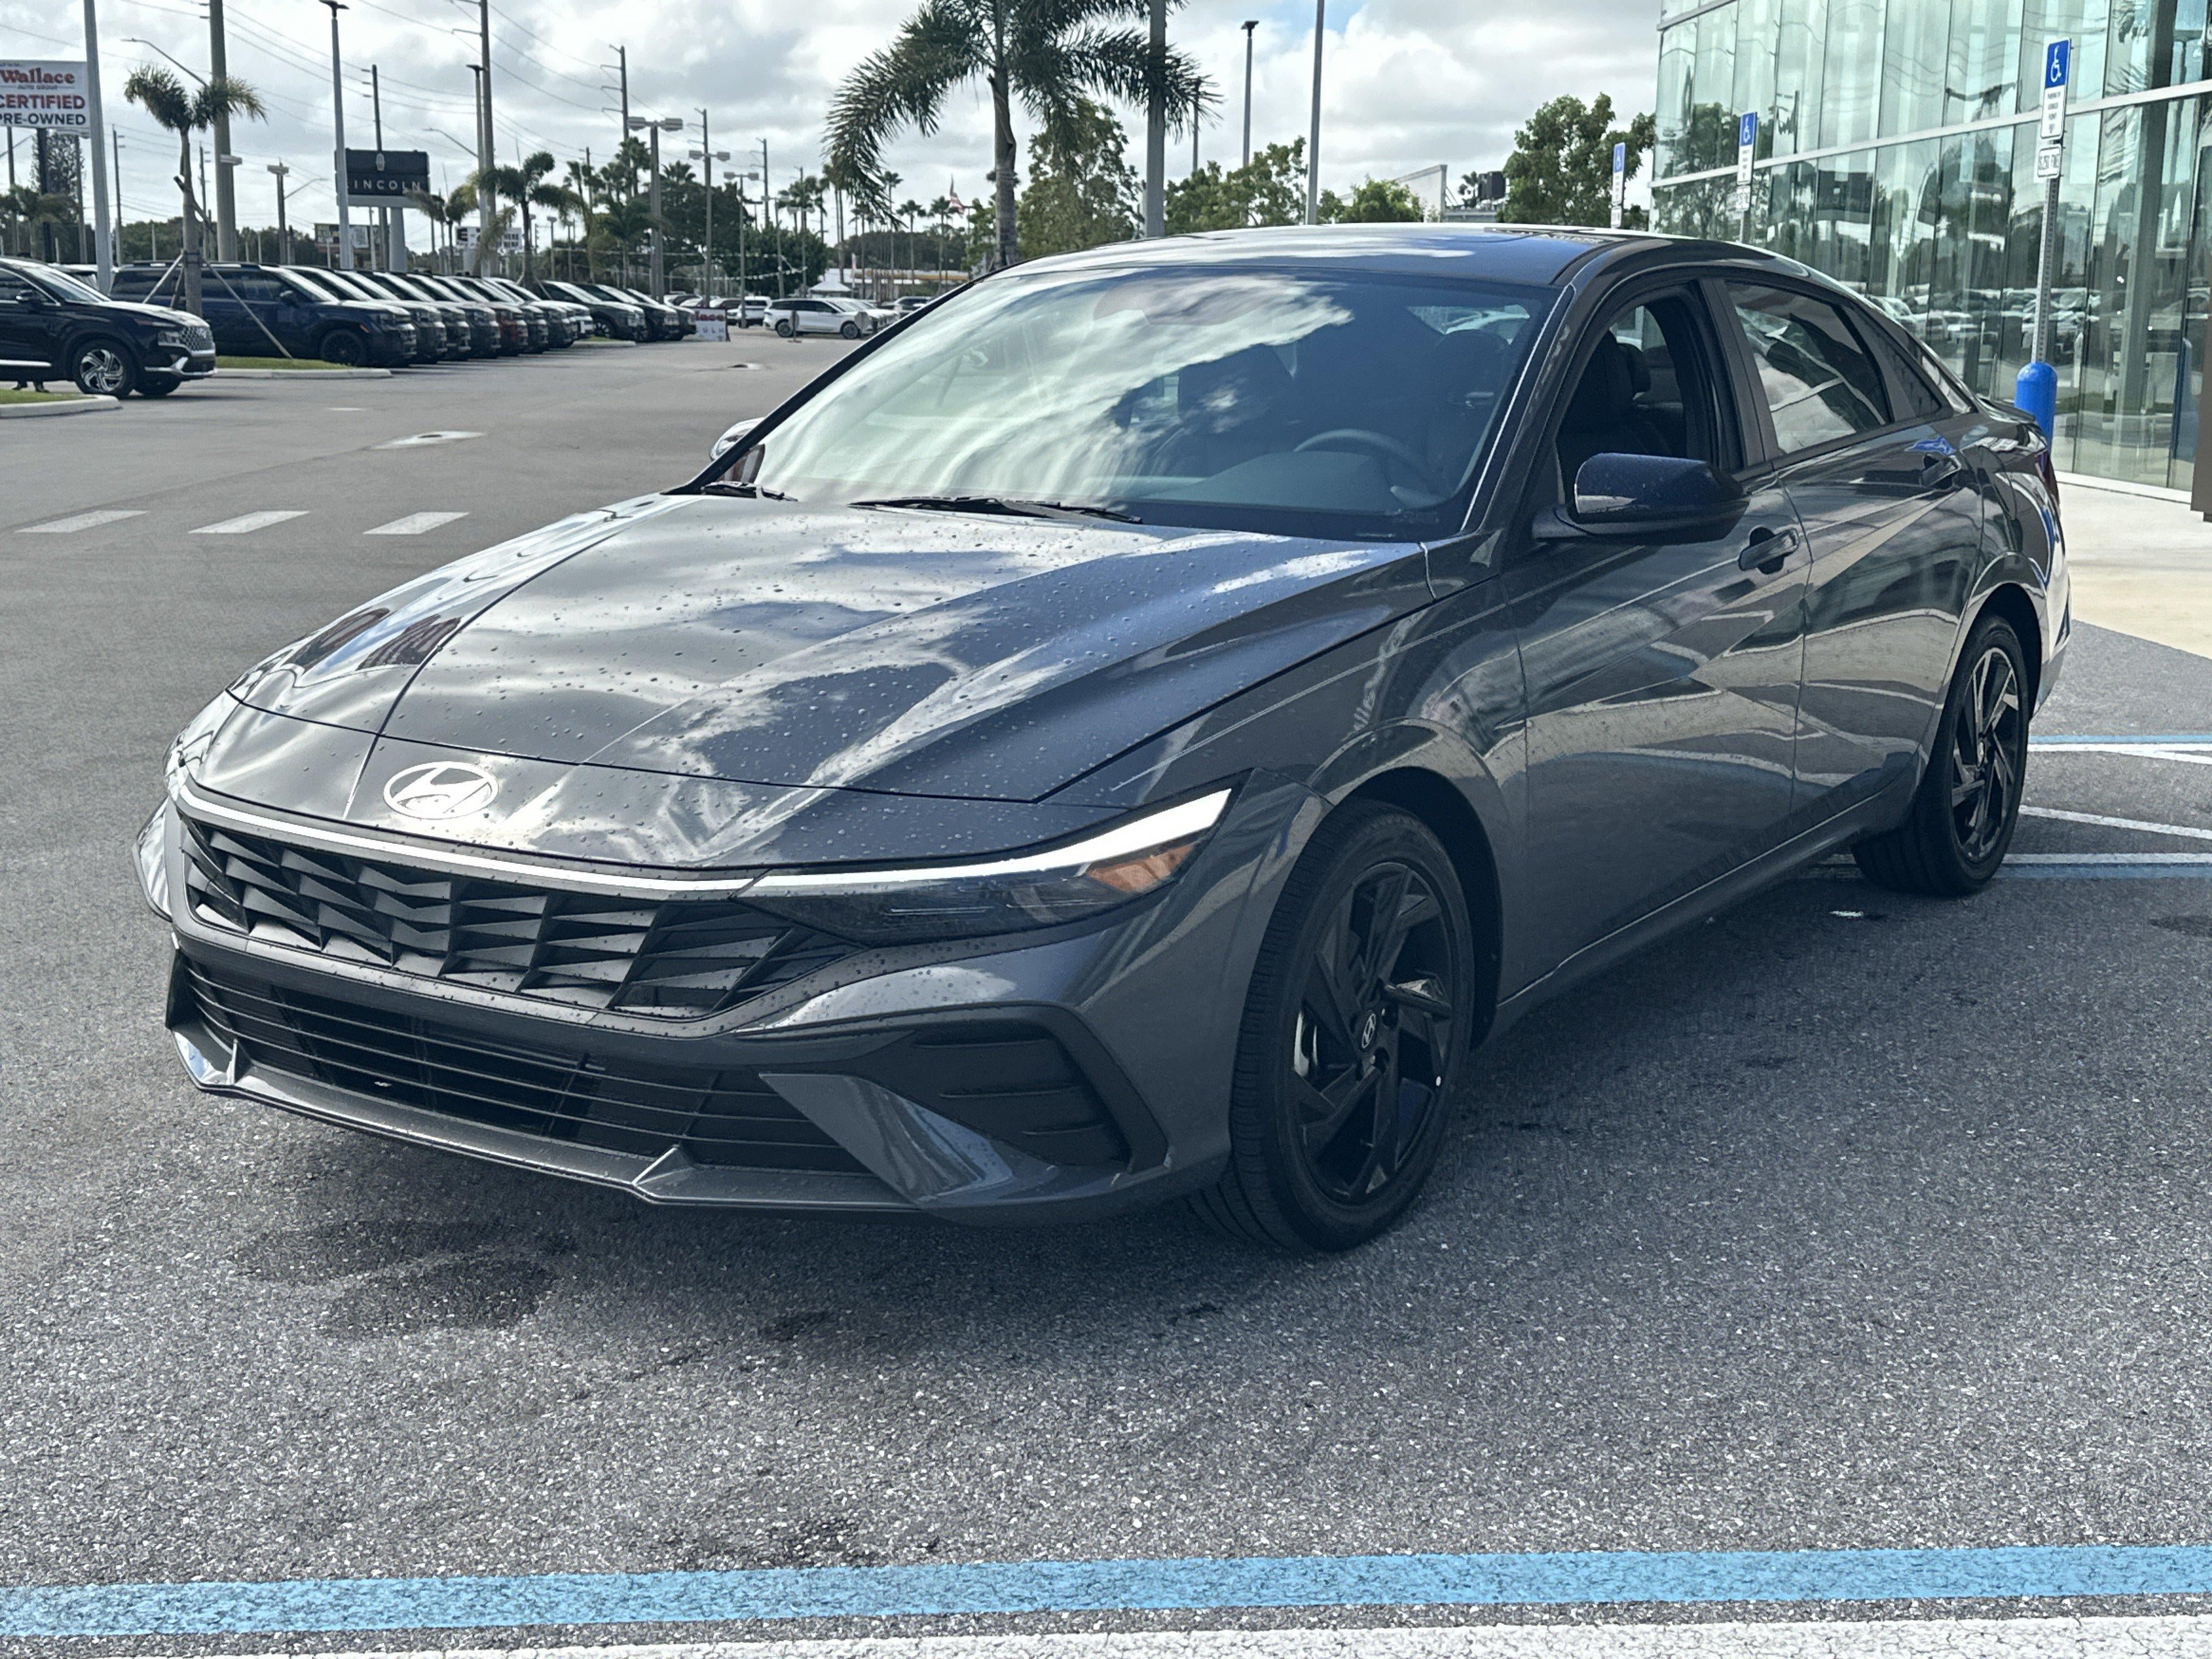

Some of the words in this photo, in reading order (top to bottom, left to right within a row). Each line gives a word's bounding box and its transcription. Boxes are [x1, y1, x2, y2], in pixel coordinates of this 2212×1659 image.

[0, 67, 75, 83] Wallace
[0, 113, 86, 125] RE-OWNED
[347, 179, 421, 191] INCOLN
